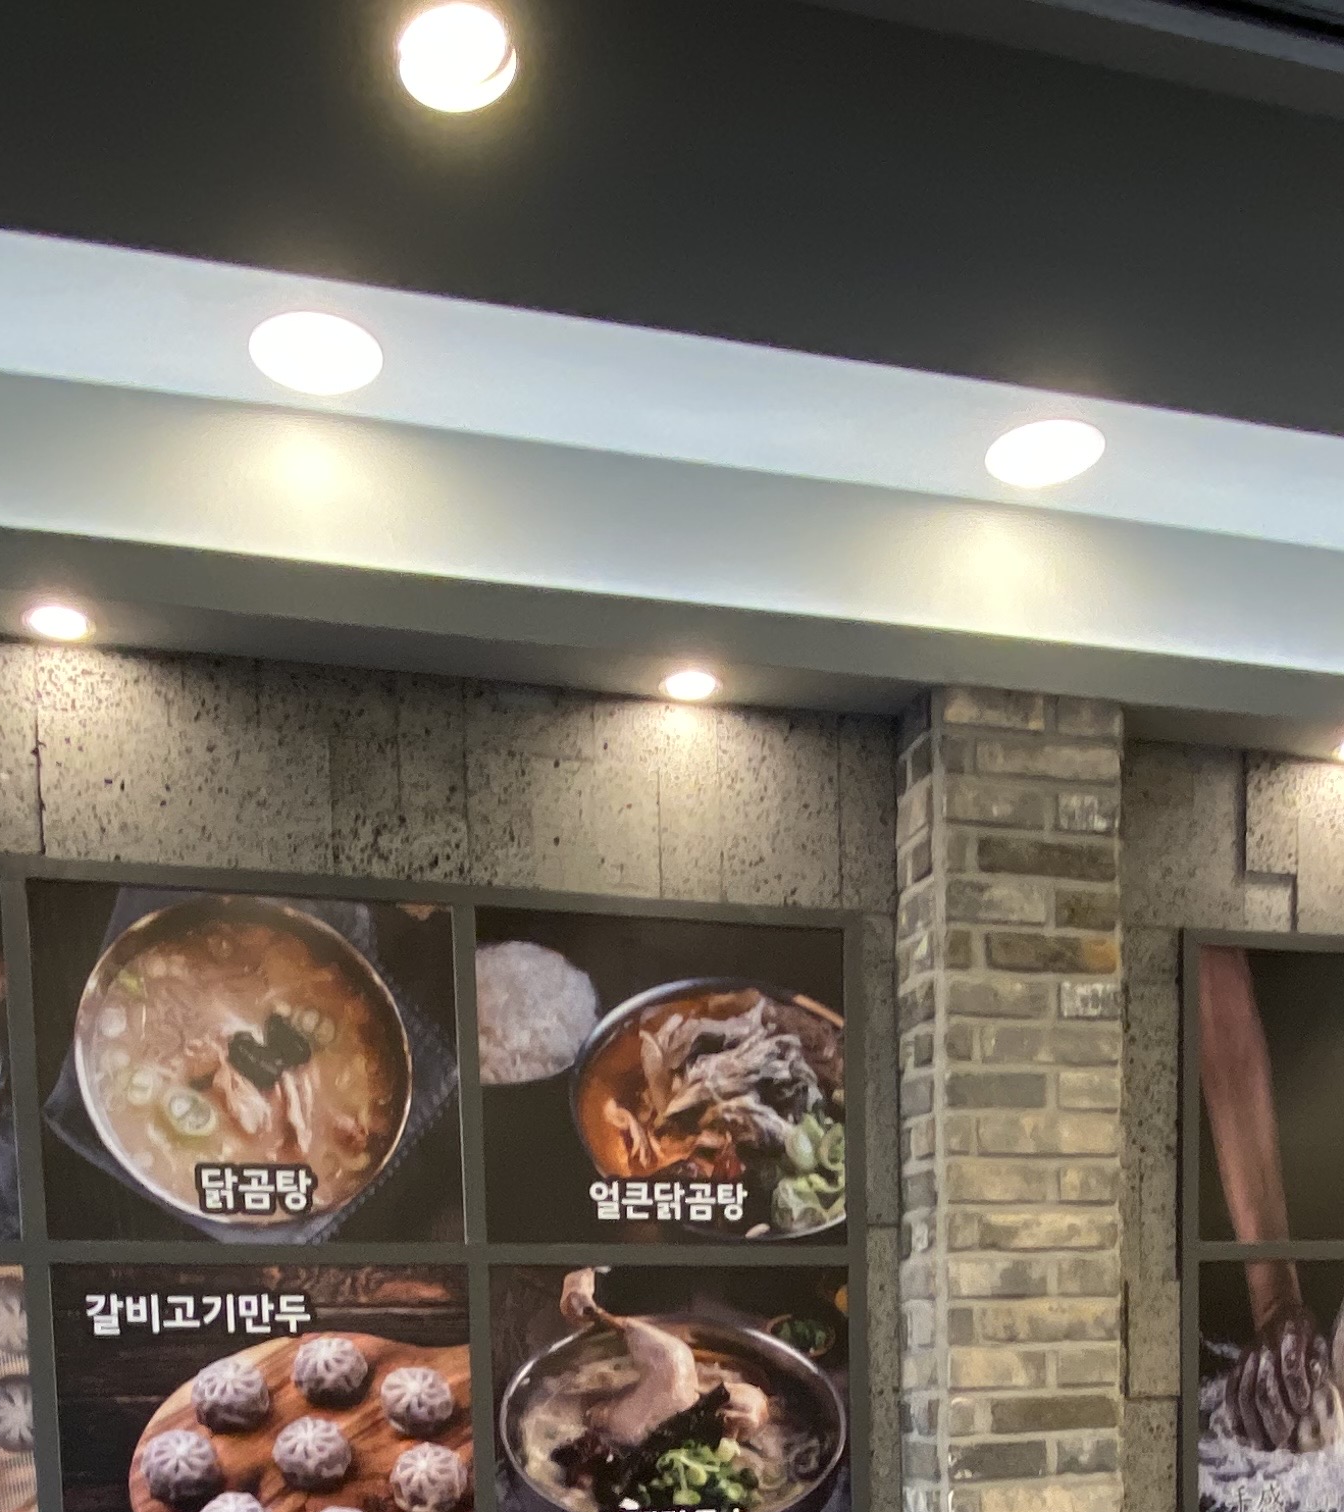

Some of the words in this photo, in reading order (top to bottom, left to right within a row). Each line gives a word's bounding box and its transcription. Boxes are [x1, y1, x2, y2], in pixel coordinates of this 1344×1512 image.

[200, 1167, 313, 1211] 닭곰탕
[589, 1180, 748, 1221] 얼큰닭곰탕
[85, 1293, 311, 1336] 갈비고기만두
